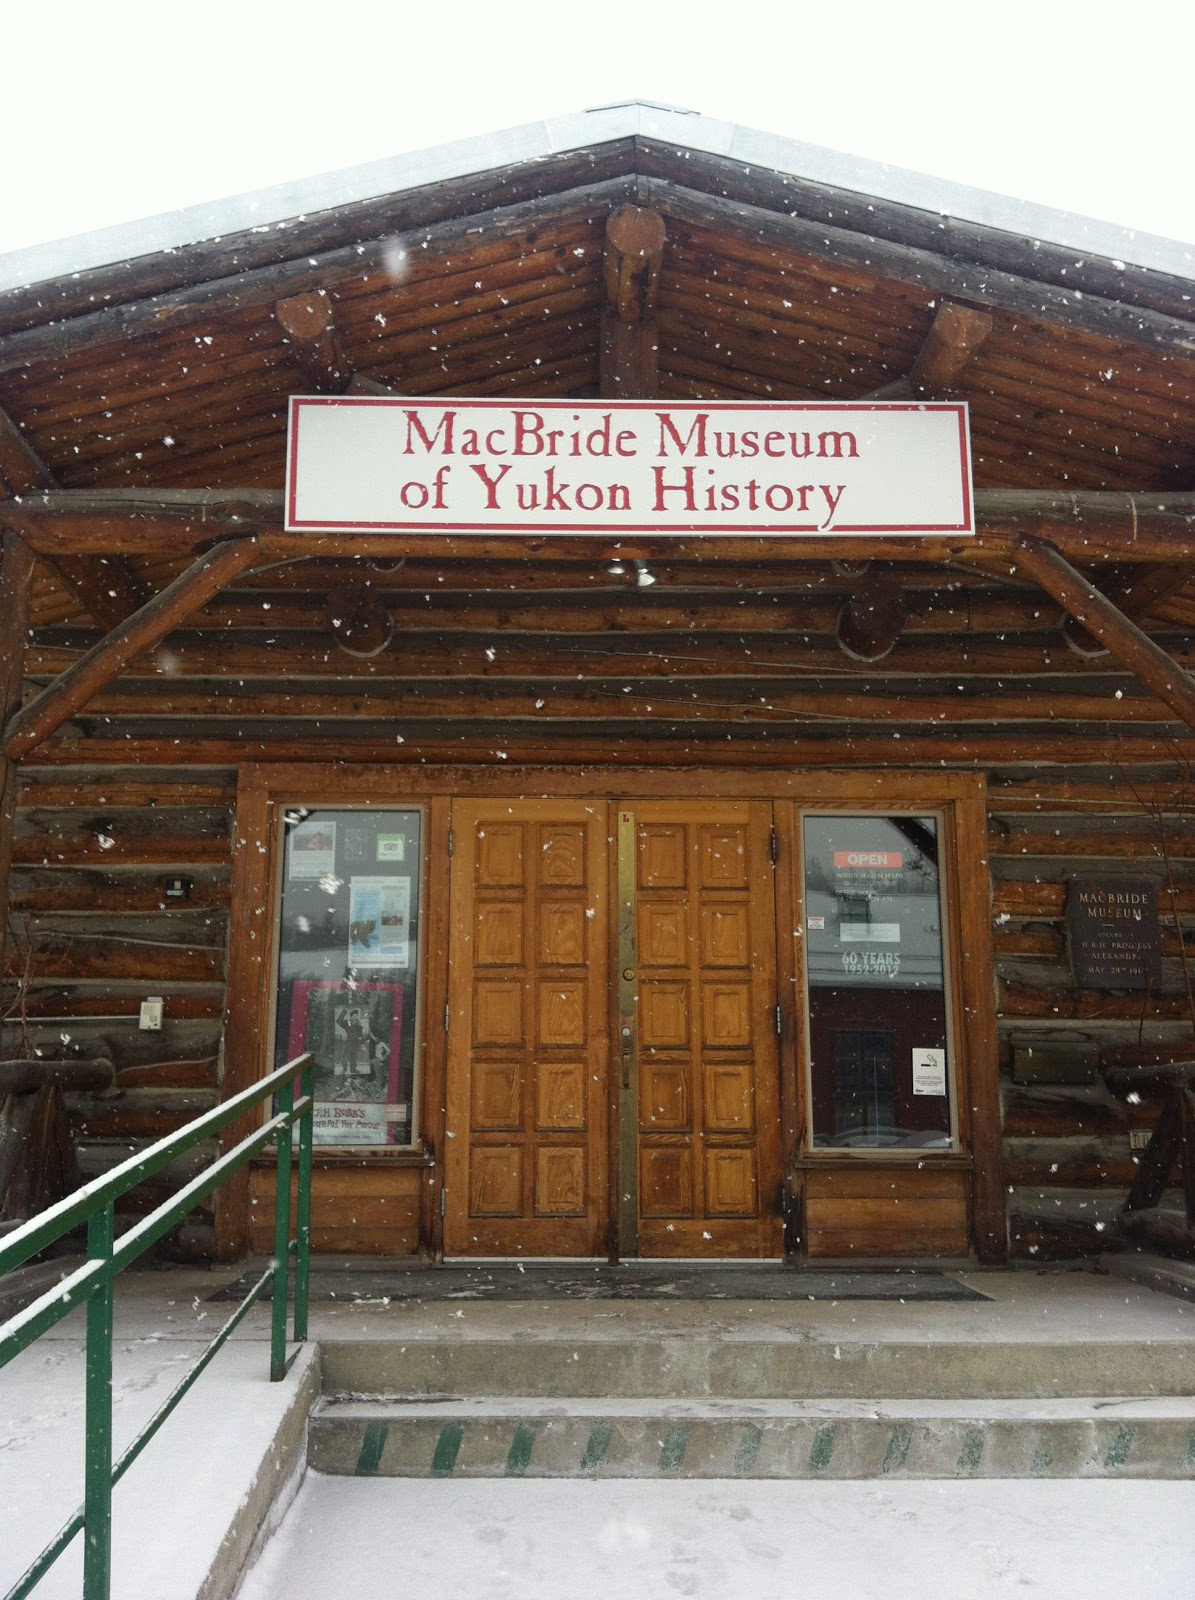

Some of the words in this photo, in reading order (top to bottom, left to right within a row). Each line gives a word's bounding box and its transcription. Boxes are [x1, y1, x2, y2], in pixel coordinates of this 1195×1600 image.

[402, 410, 637, 457] MacBride
[655, 412, 860, 459] Museum
[400, 465, 451, 510] of
[469, 464, 632, 511] Yukon
[651, 465, 846, 531] History
[847, 854, 888, 866] OPEN
[1087, 907, 1142, 919] MUSEUM
[842, 952, 858, 965] 60
[861, 952, 901, 966] YEARS
